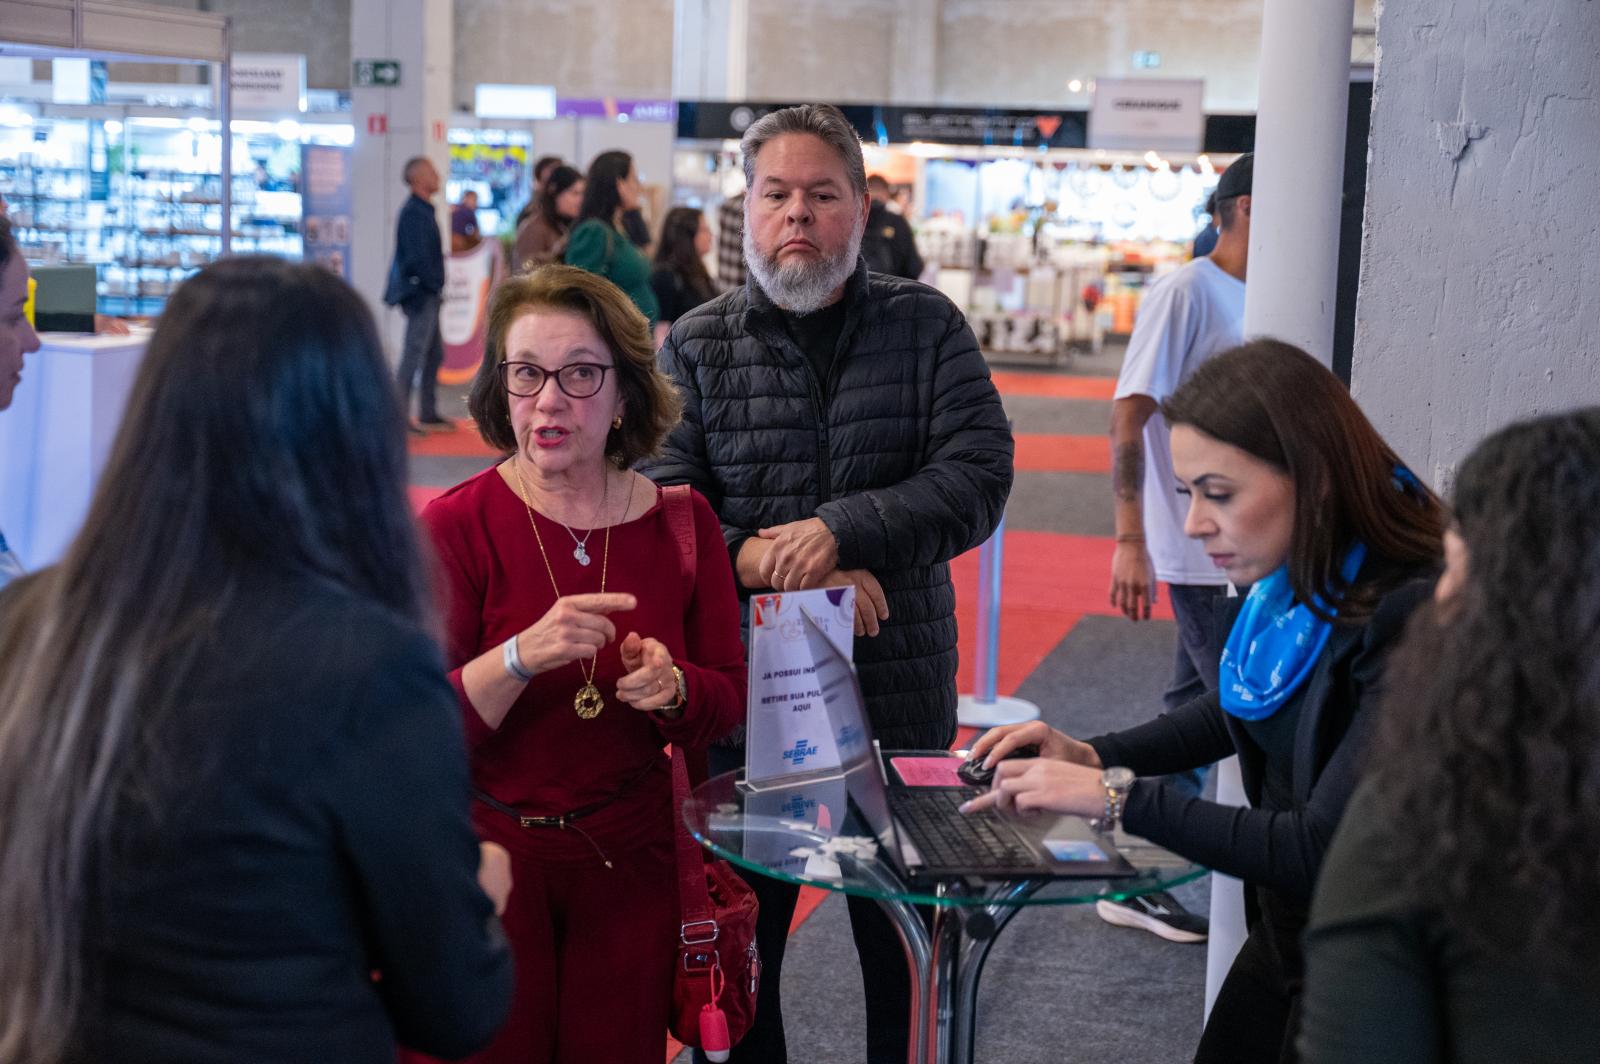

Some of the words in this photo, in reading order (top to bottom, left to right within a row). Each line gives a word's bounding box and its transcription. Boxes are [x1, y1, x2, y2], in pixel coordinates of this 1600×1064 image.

[773, 669, 801, 679] POSSUI
[761, 694, 788, 704] RETIRE
[789, 691, 805, 700] SUA
[806, 690, 822, 698] PUL
[792, 703, 811, 712] AQUI
[782, 746, 818, 759] SEBRAE
